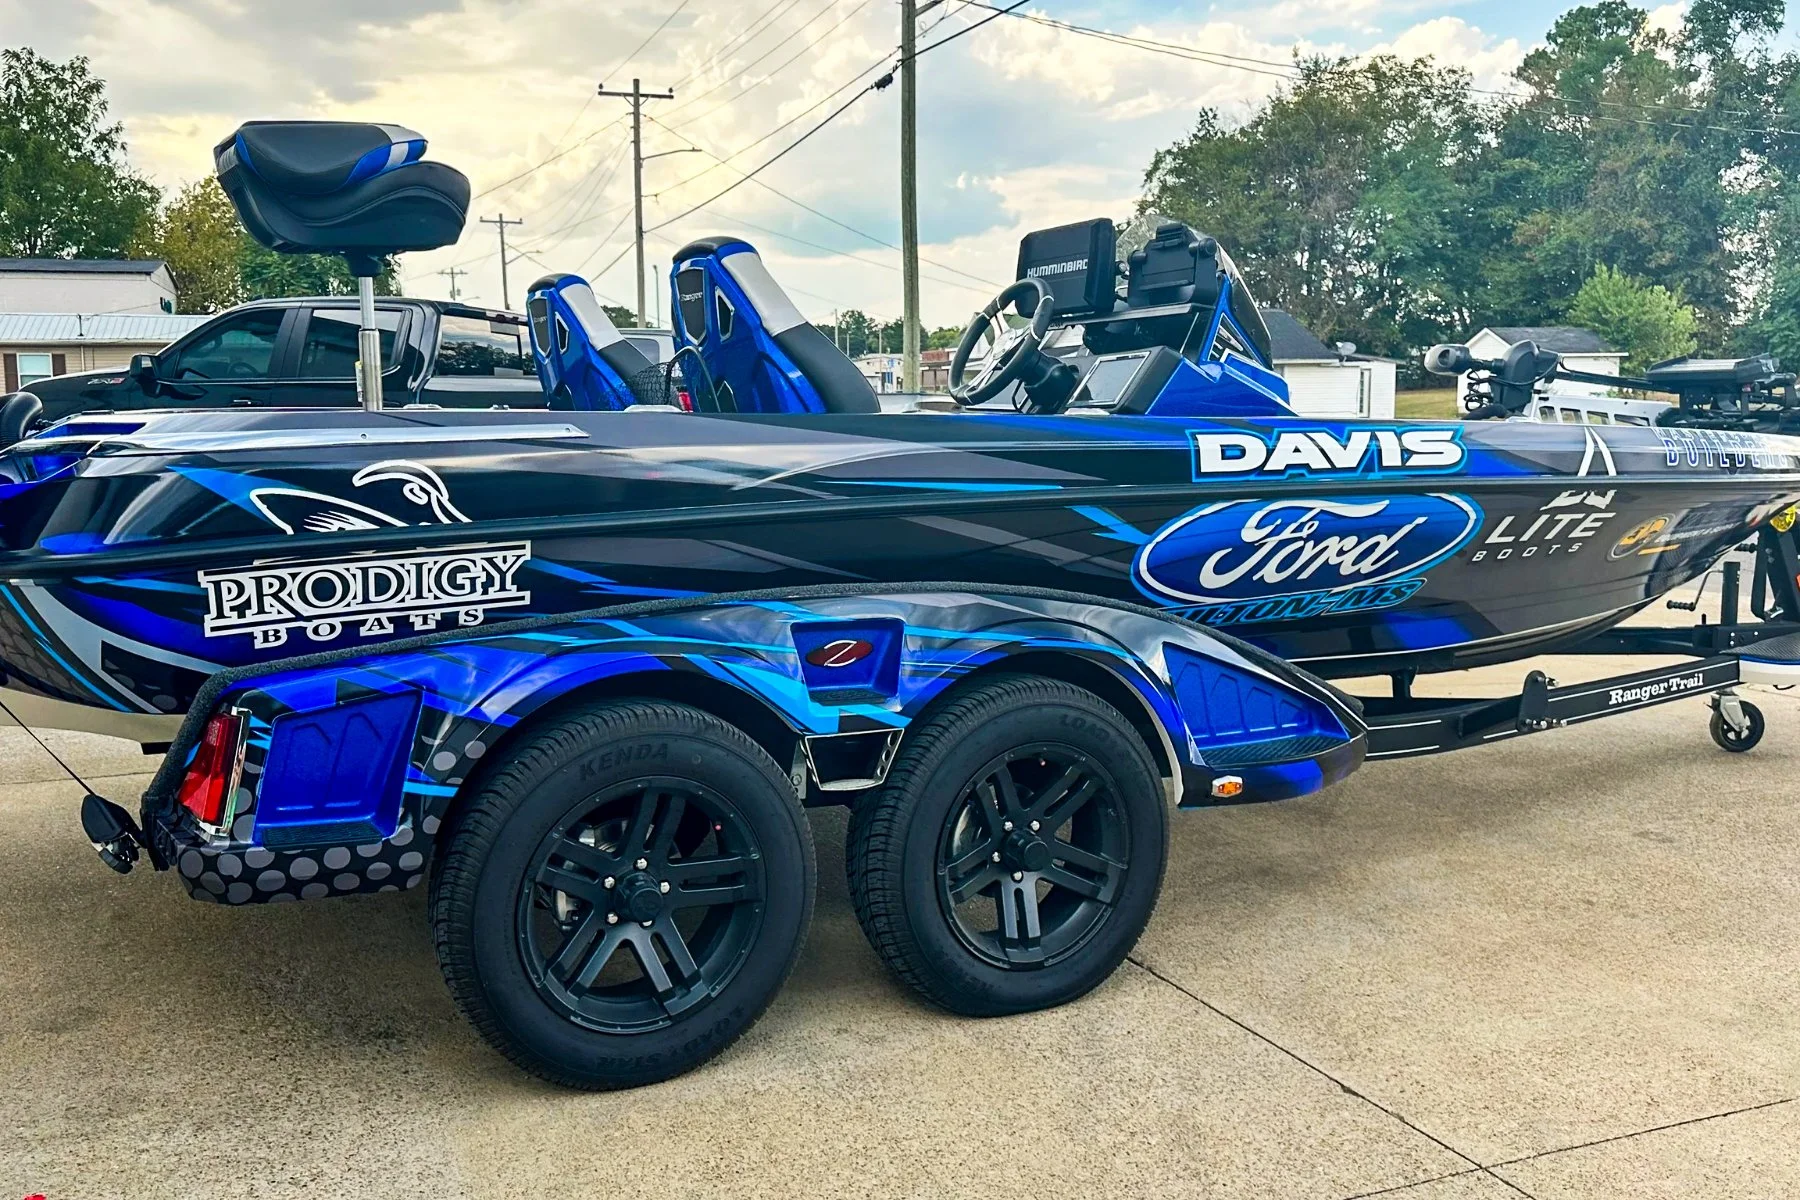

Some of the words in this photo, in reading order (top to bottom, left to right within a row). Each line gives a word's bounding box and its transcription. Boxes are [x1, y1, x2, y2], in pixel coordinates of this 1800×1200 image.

[1027, 258, 1088, 279] HUMMINBIRD
[1196, 431, 1463, 473] DAVIS
[1200, 499, 1429, 589] Ford
[1485, 512, 1617, 544] LITE
[1471, 542, 1583, 562] BOOTS
[206, 553, 528, 622] PRODIGY
[257, 606, 483, 647] BOATS
[1608, 682, 1668, 705] Ranger
[1668, 673, 1704, 692] Trail
[580, 743, 669, 780] KENDA
